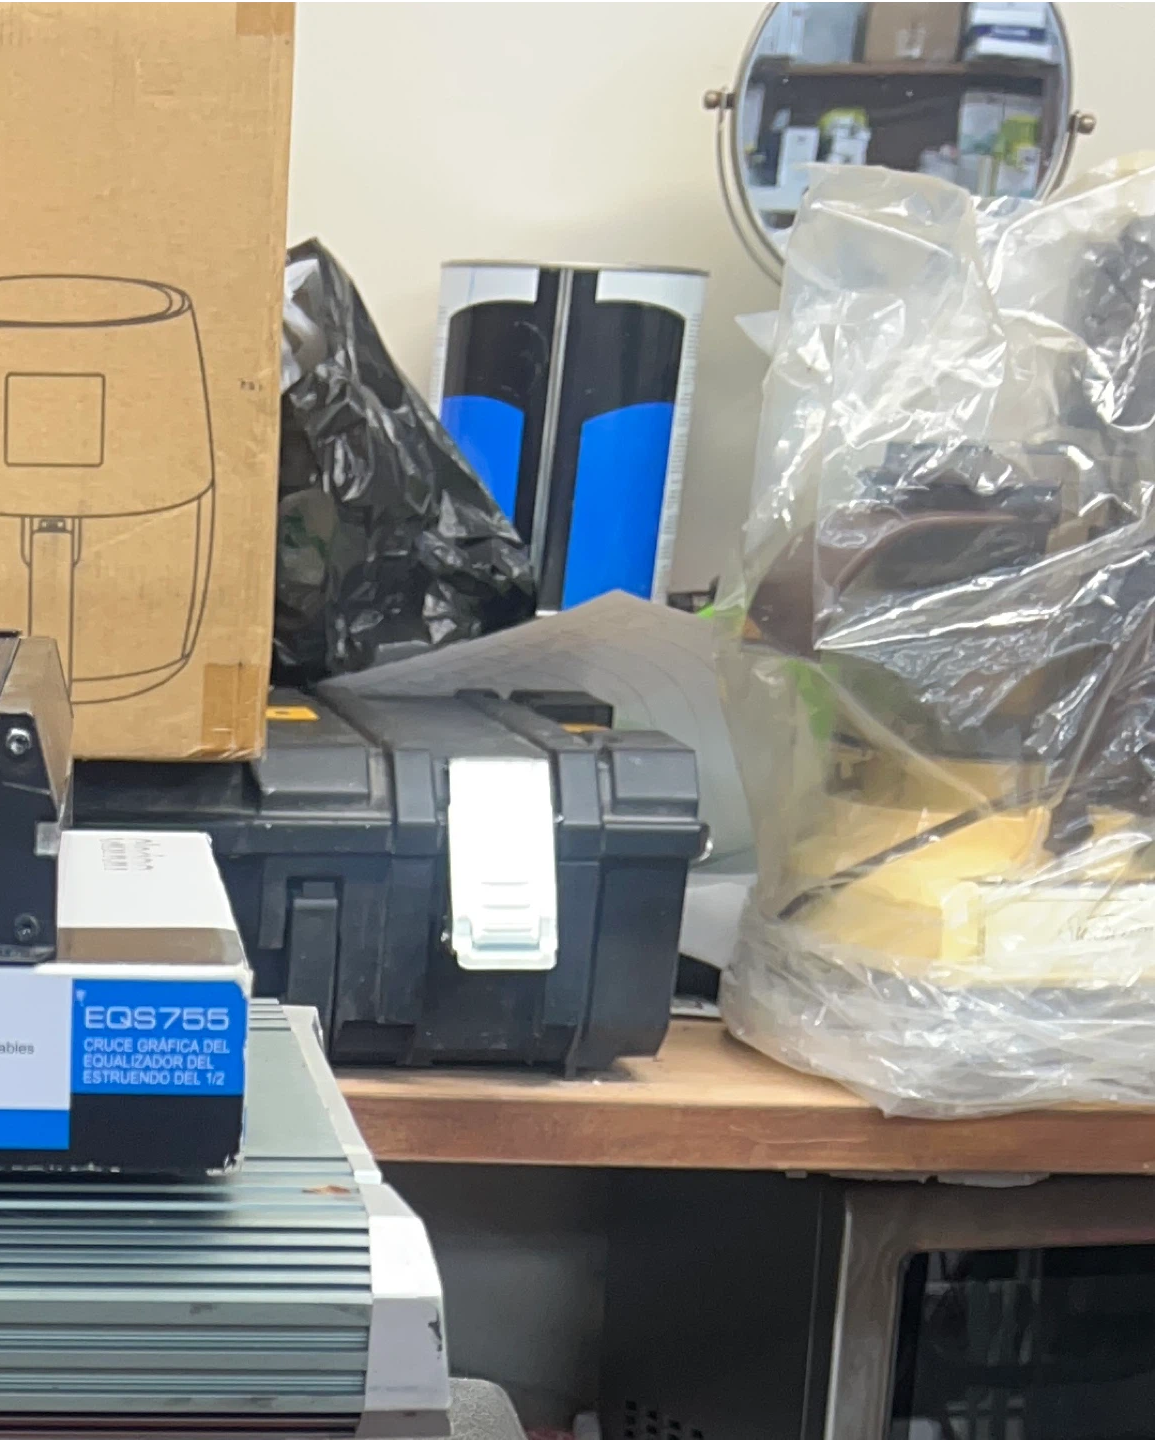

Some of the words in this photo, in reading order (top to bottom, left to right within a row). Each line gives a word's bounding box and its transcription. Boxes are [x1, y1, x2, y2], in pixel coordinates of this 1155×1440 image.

[84, 1006, 230, 1031] EQS755
[83, 1036, 134, 1053] CRUCE
[203, 1038, 231, 1054] DEL
[83, 1054, 183, 1070] EQUALIZADOR
[187, 1055, 215, 1070] DEL
[82, 1070, 170, 1085] ESTRUENDO
[174, 1071, 201, 1086] DEL
[206, 1071, 226, 1087] 1/2
